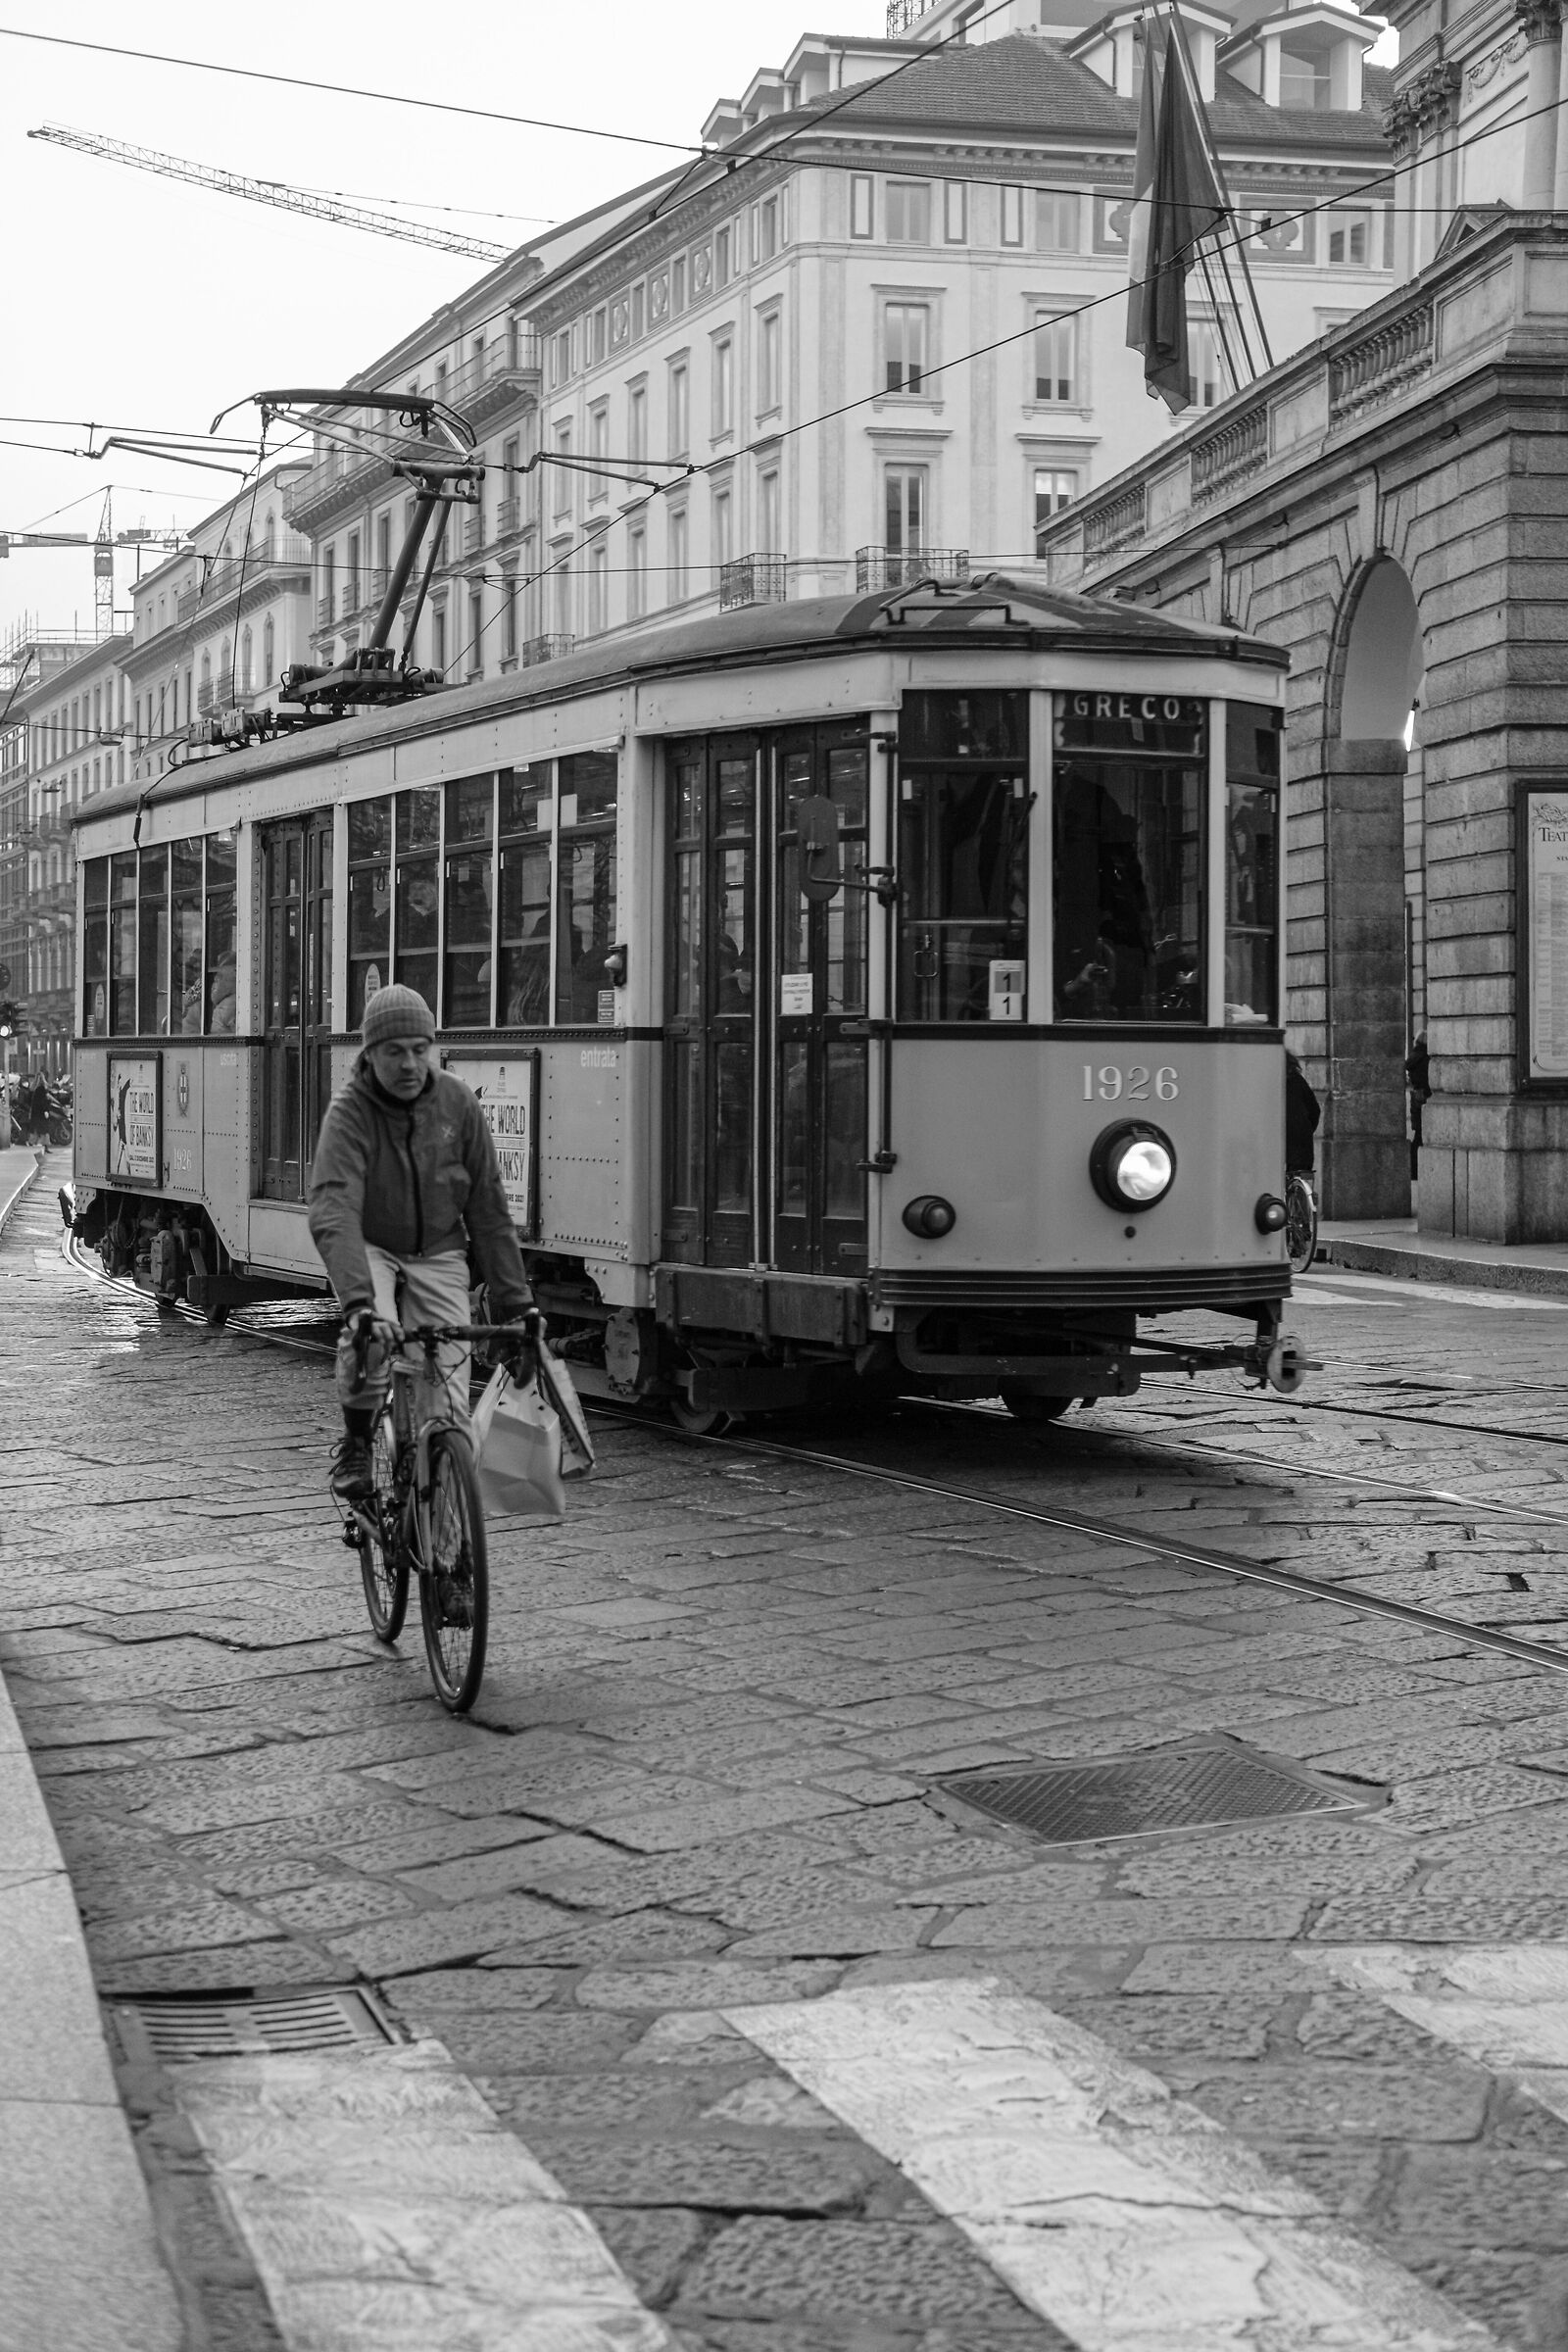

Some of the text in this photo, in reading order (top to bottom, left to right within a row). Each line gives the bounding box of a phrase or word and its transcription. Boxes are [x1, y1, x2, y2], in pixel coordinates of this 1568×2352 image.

[1073, 694, 1180, 719] GRECO
[1003, 972, 1011, 992] 1
[1003, 996, 1010, 1015] 1
[580, 1046, 616, 1067] entrata
[1082, 1065, 1179, 1101] 1926
[498, 1104, 525, 1135] WORLD
